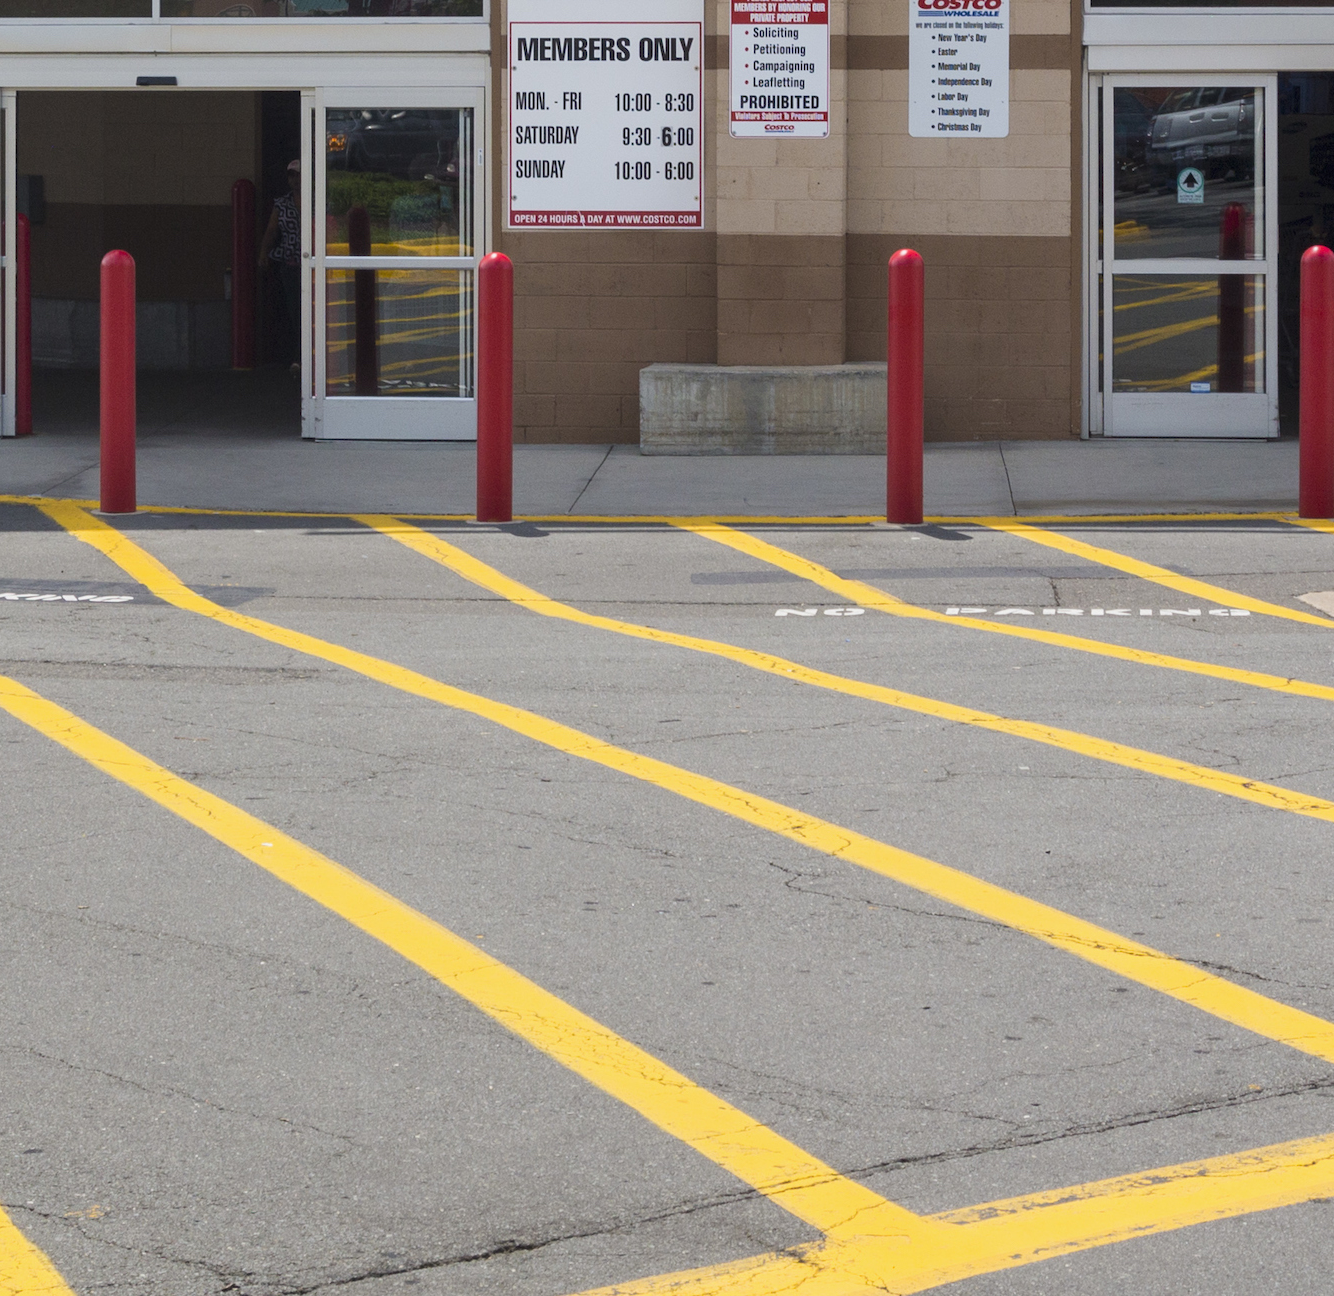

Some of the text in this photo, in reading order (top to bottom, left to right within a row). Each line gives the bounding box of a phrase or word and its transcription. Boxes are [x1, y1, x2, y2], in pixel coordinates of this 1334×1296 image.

[734, 3, 767, 12] MEMBERS
[750, 13, 809, 22] PRIVATE PROPERTY
[753, 27, 799, 40] Soliciting
[938, 33, 987, 43] New Year's Day
[517, 37, 694, 62] MEMBERS ONLY
[753, 43, 806, 57] Petitioning
[938, 48, 957, 56] Easter
[753, 60, 815, 73] Campaigning
[938, 62, 981, 72] Memorial Day
[753, 77, 805, 90] Leafletting
[938, 77, 992, 87] Independence Day
[516, 91, 549, 111] MON.
[563, 91, 582, 110] FRI
[615, 93, 652, 112] 10:00
[665, 93, 694, 112] 8:30
[740, 95, 819, 109] PROHIBITED
[938, 92, 968, 102] Labor Day
[938, 107, 990, 117] Thanksgiving Day
[937, 122, 982, 132] Christmas Day
[515, 125, 579, 145] SATURDAY
[622, 127, 652, 146] 9:30
[515, 159, 566, 179] SUNDAY
[614, 161, 652, 181] 10:00
[665, 161, 694, 181] 6:00
[514, 214, 536, 224] OPEN
[538, 214, 548, 224] 24
[549, 214, 578, 224] HOURS
[588, 214, 603, 224] DAY
[605, 214, 615, 224] AT
[617, 214, 697, 224] WWW.COSTCO.COM
[774, 606, 1251, 617] NO PARKING
